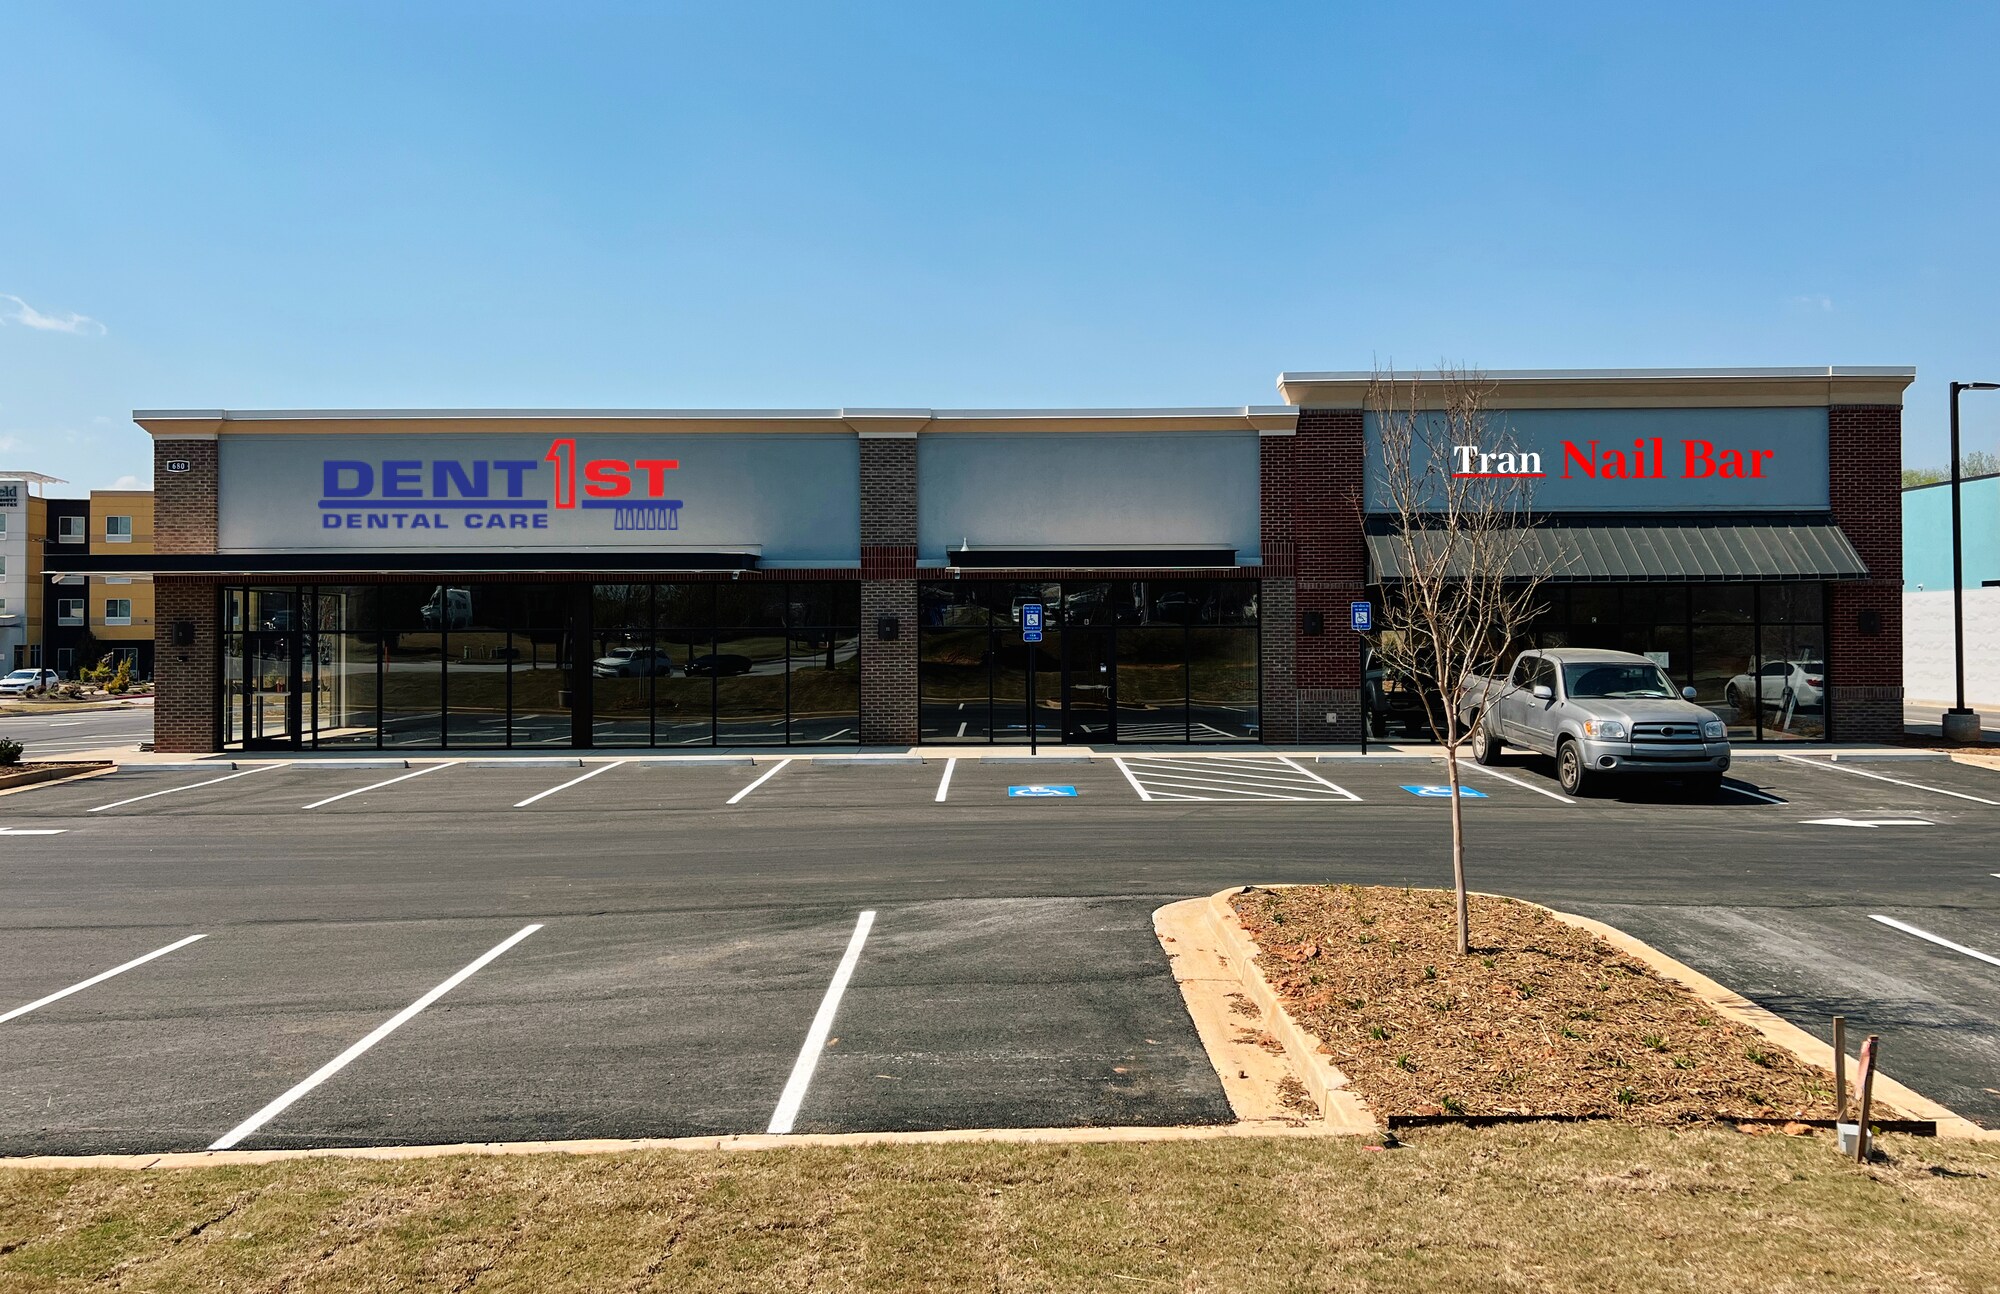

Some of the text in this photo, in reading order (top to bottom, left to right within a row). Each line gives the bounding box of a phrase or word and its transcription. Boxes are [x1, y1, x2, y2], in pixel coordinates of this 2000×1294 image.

[1453, 437, 1774, 479] Tran Nail Bar
[323, 513, 549, 529] DENTAL CARE
